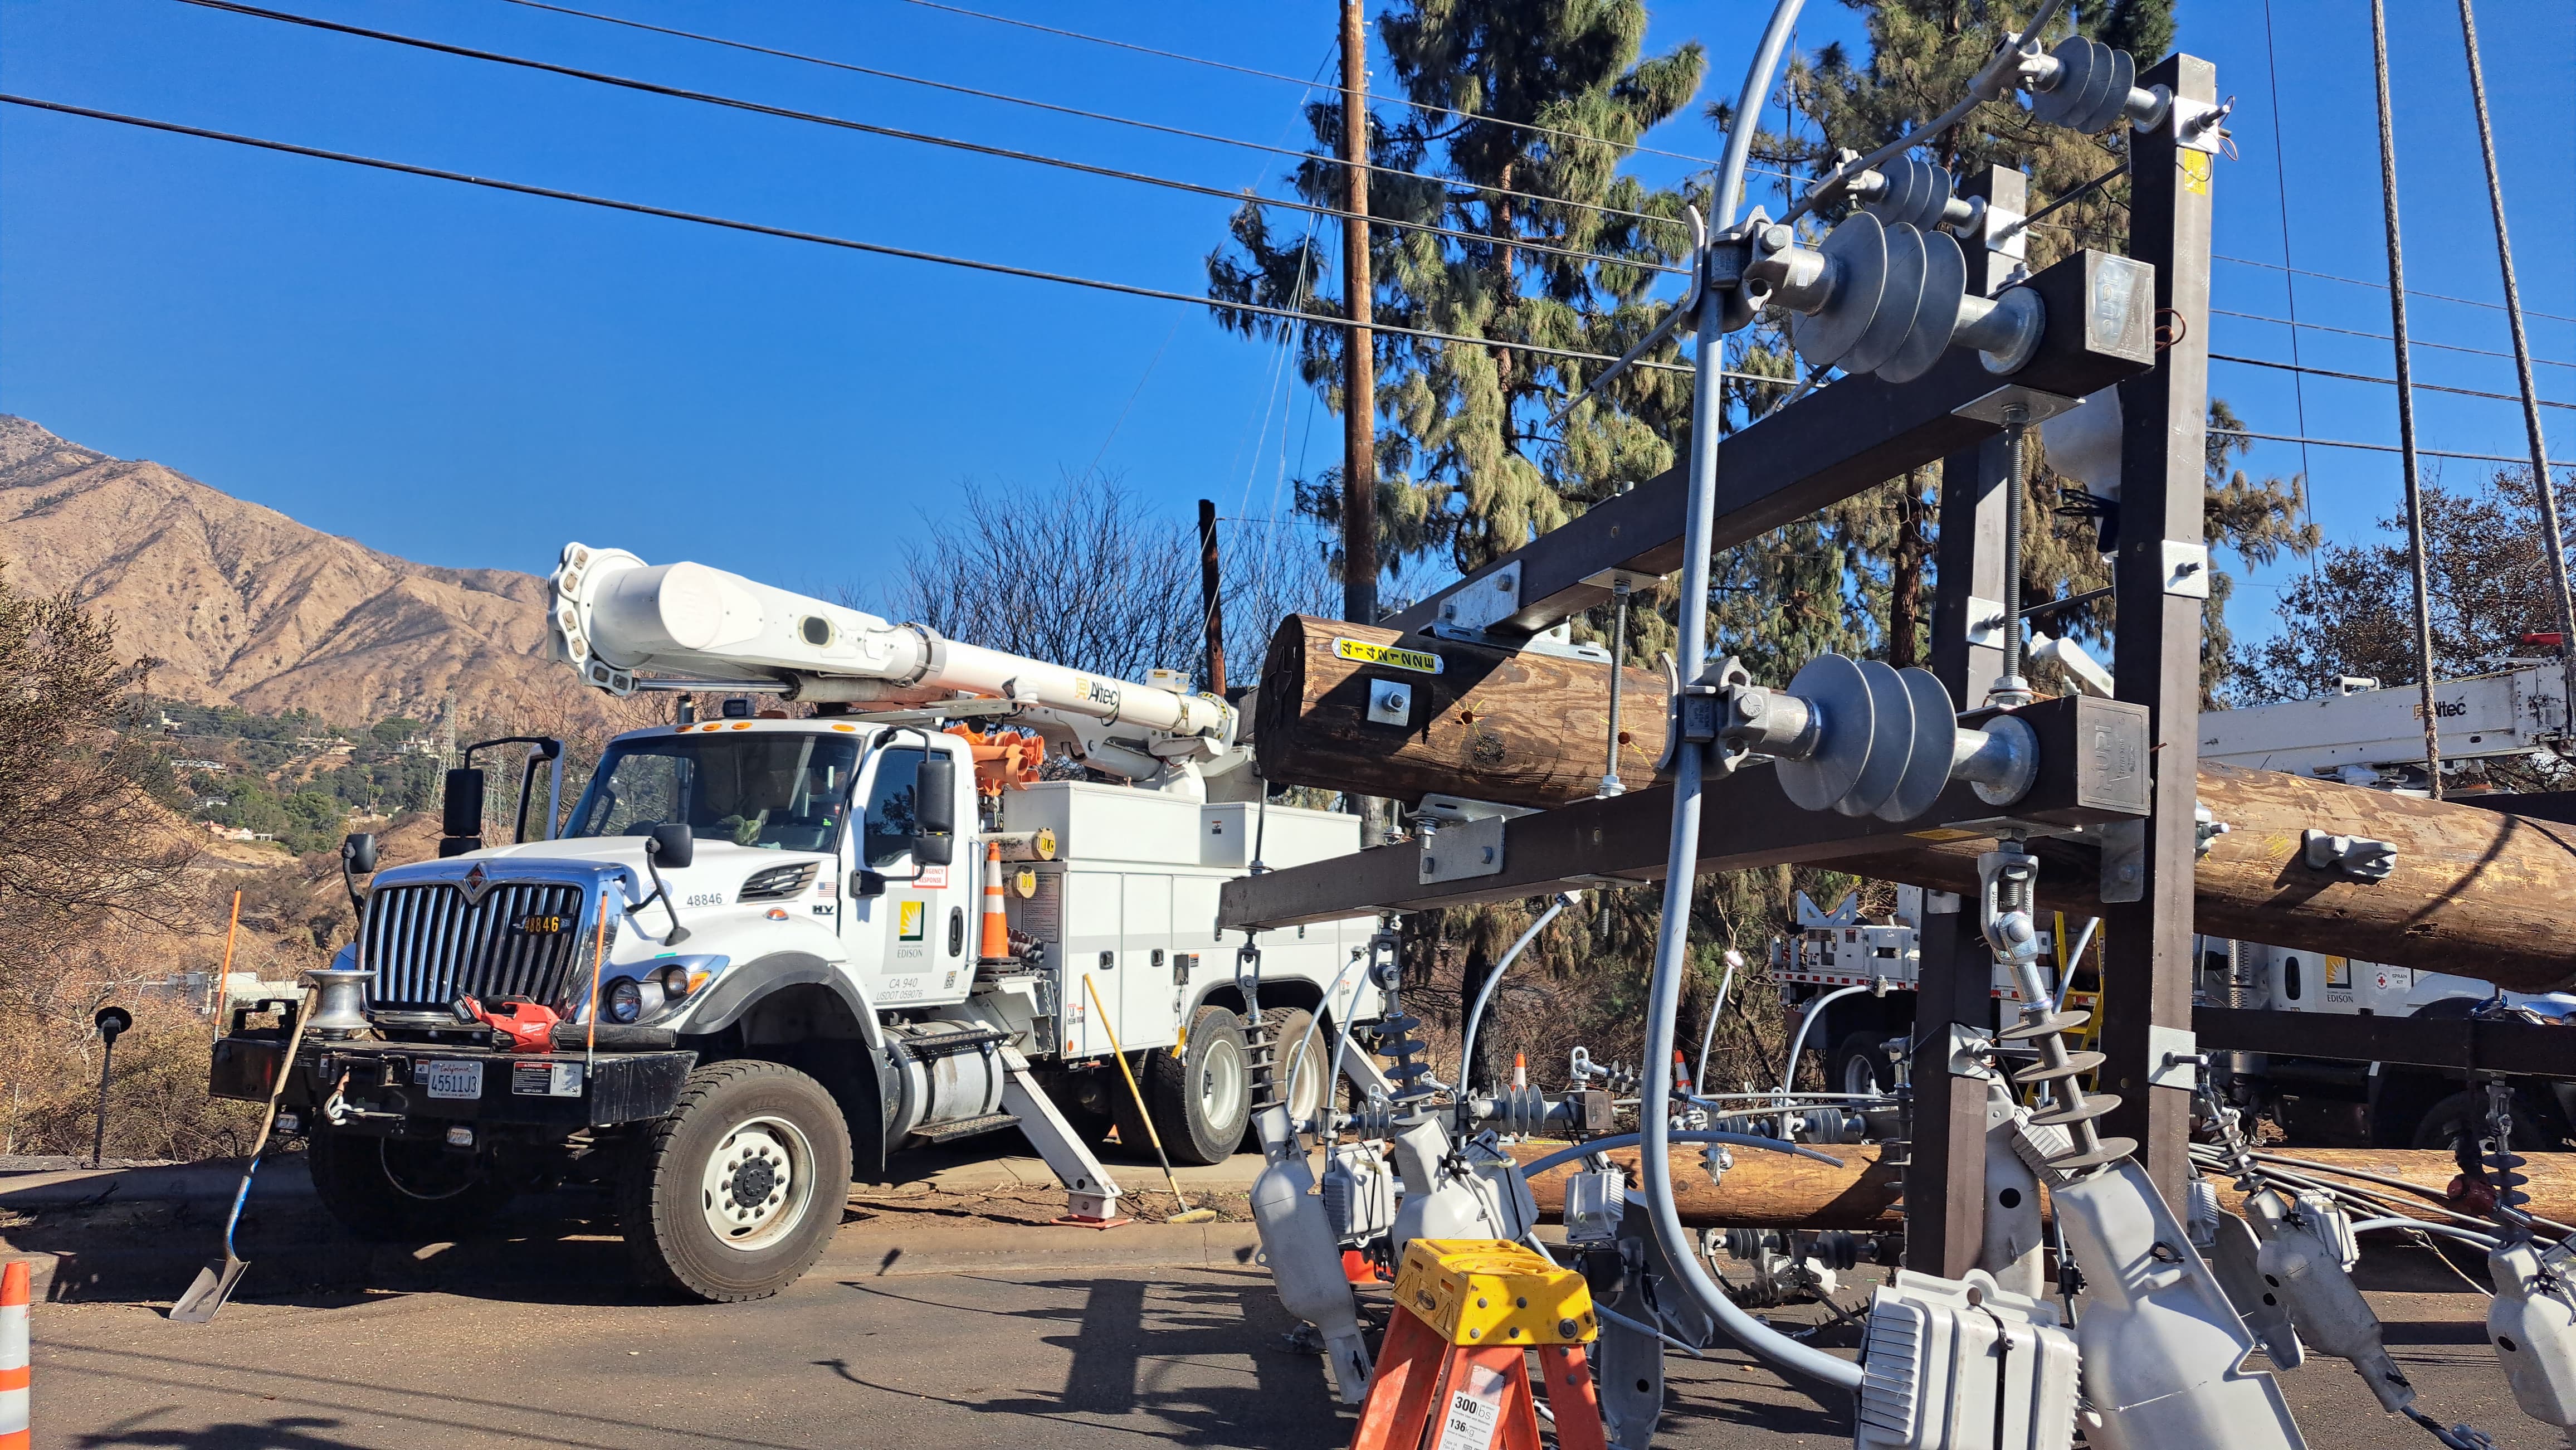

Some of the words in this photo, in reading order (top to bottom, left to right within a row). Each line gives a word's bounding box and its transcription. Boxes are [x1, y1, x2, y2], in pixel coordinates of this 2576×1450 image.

[1088, 681, 1118, 705] Altec
[1041, 837, 1055, 853] RLC
[687, 893, 722, 906] 48846
[812, 905, 835, 915] HV
[525, 916, 559, 932] 48846
[897, 948, 923, 958] EDISON
[889, 979, 900, 989] CA
[902, 977, 918, 988] 940
[876, 990, 899, 1000] USDOT
[2327, 994, 2354, 1003] EDISON
[431, 1074, 478, 1093] 45511J3
